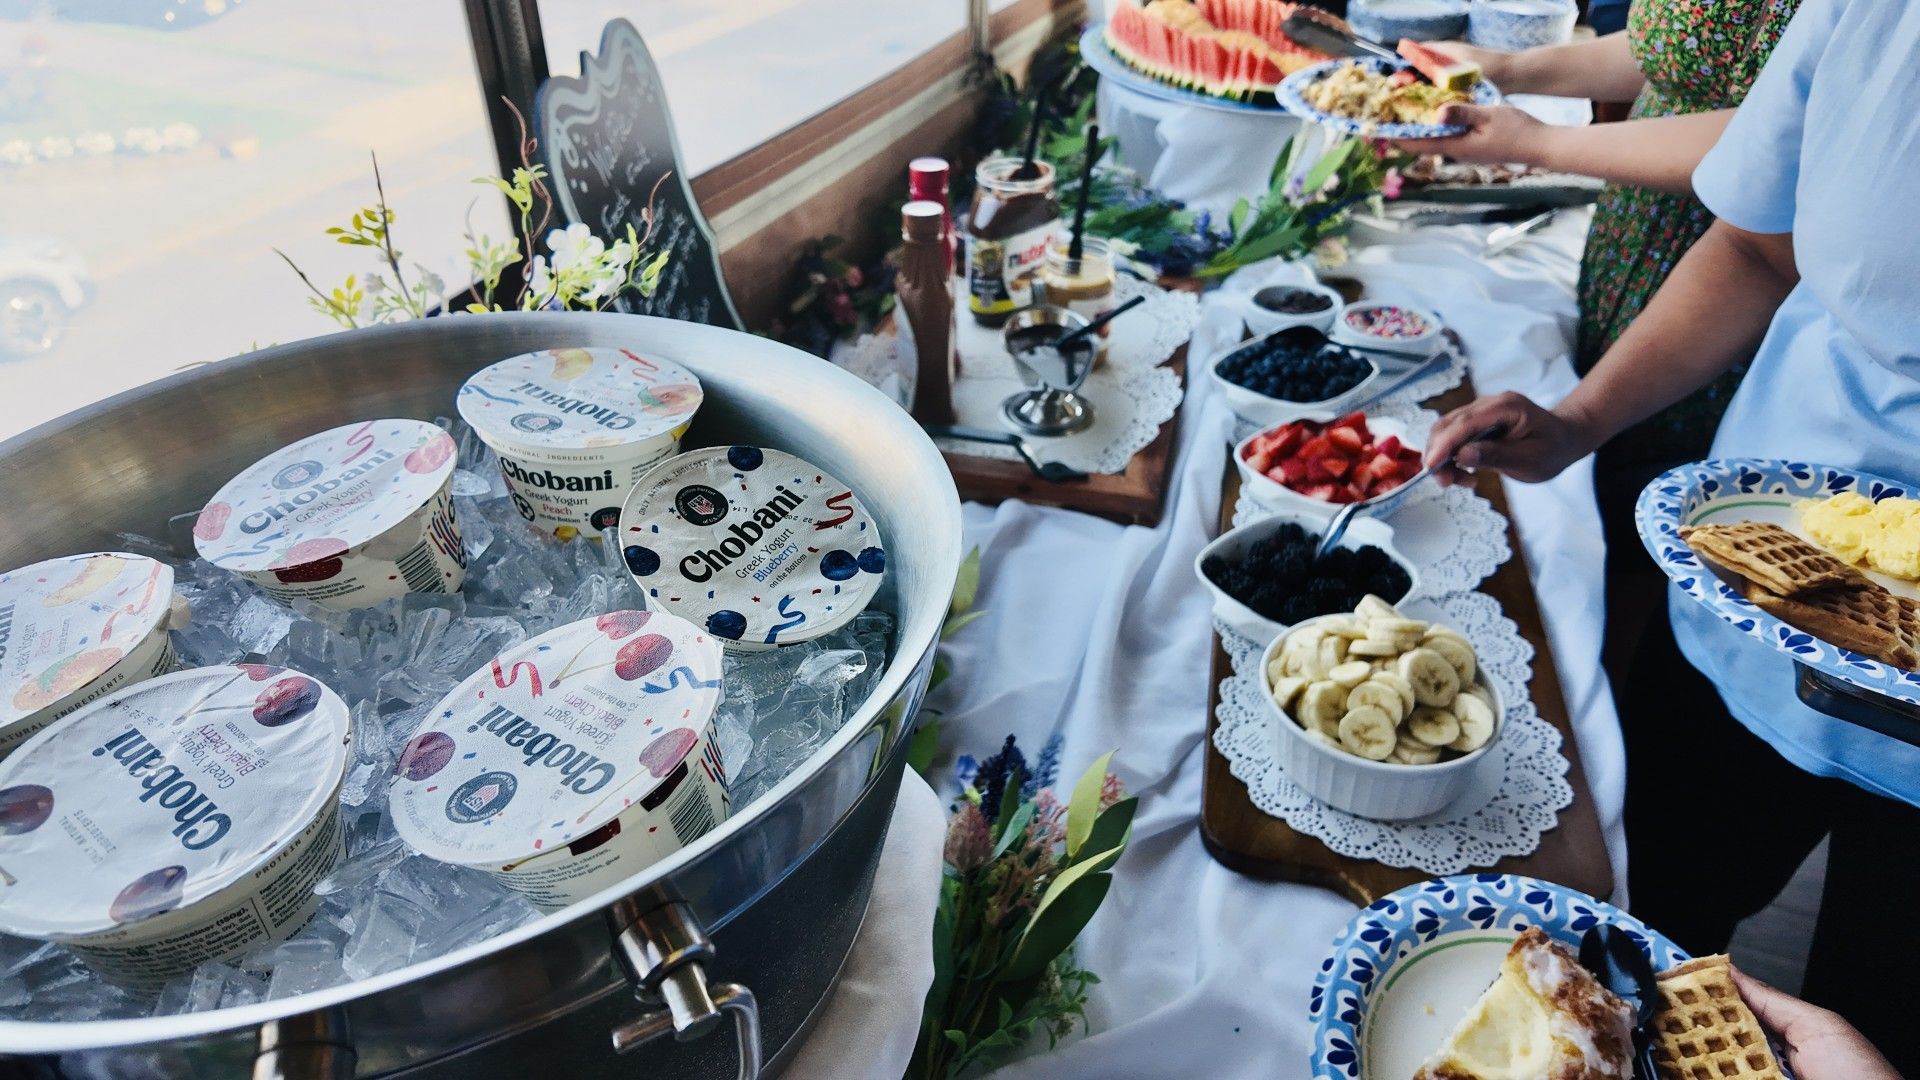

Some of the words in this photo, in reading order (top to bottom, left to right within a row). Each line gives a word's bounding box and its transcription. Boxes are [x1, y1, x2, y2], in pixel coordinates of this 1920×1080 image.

[510, 382, 637, 430] Chobani
[239, 448, 396, 535] Chobani
[500, 456, 614, 492] Chobani
[648, 476, 673, 498] NATURAL
[295, 500, 331, 523] Greek
[331, 478, 372, 503] Yogurt
[524, 488, 552, 502] Greek
[553, 495, 589, 506] Yogurt
[542, 503, 573, 516] Peach
[679, 484, 804, 583] Chobani
[735, 554, 766, 579] Greek
[761, 528, 795, 556] Yogurt
[752, 542, 800, 583] Blueberry
[769, 580, 780, 590] on
[777, 572, 788, 583] the
[785, 553, 808, 575] Bottom
[0, 719, 47, 745] ATURAL
[53, 672, 125, 722] INGREDIENTS
[543, 705, 578, 731] Yogurt
[562, 690, 596, 716] Cherry
[594, 709, 625, 731] Black
[180, 736, 210, 767] Yogurt
[197, 723, 231, 755] Cherry
[467, 704, 617, 795] Chobani
[576, 721, 610, 746] Greek
[202, 760, 235, 789] Greek
[225, 750, 256, 777] Black
[92, 727, 232, 850] Chobani
[255, 838, 303, 879] PROTEIN
